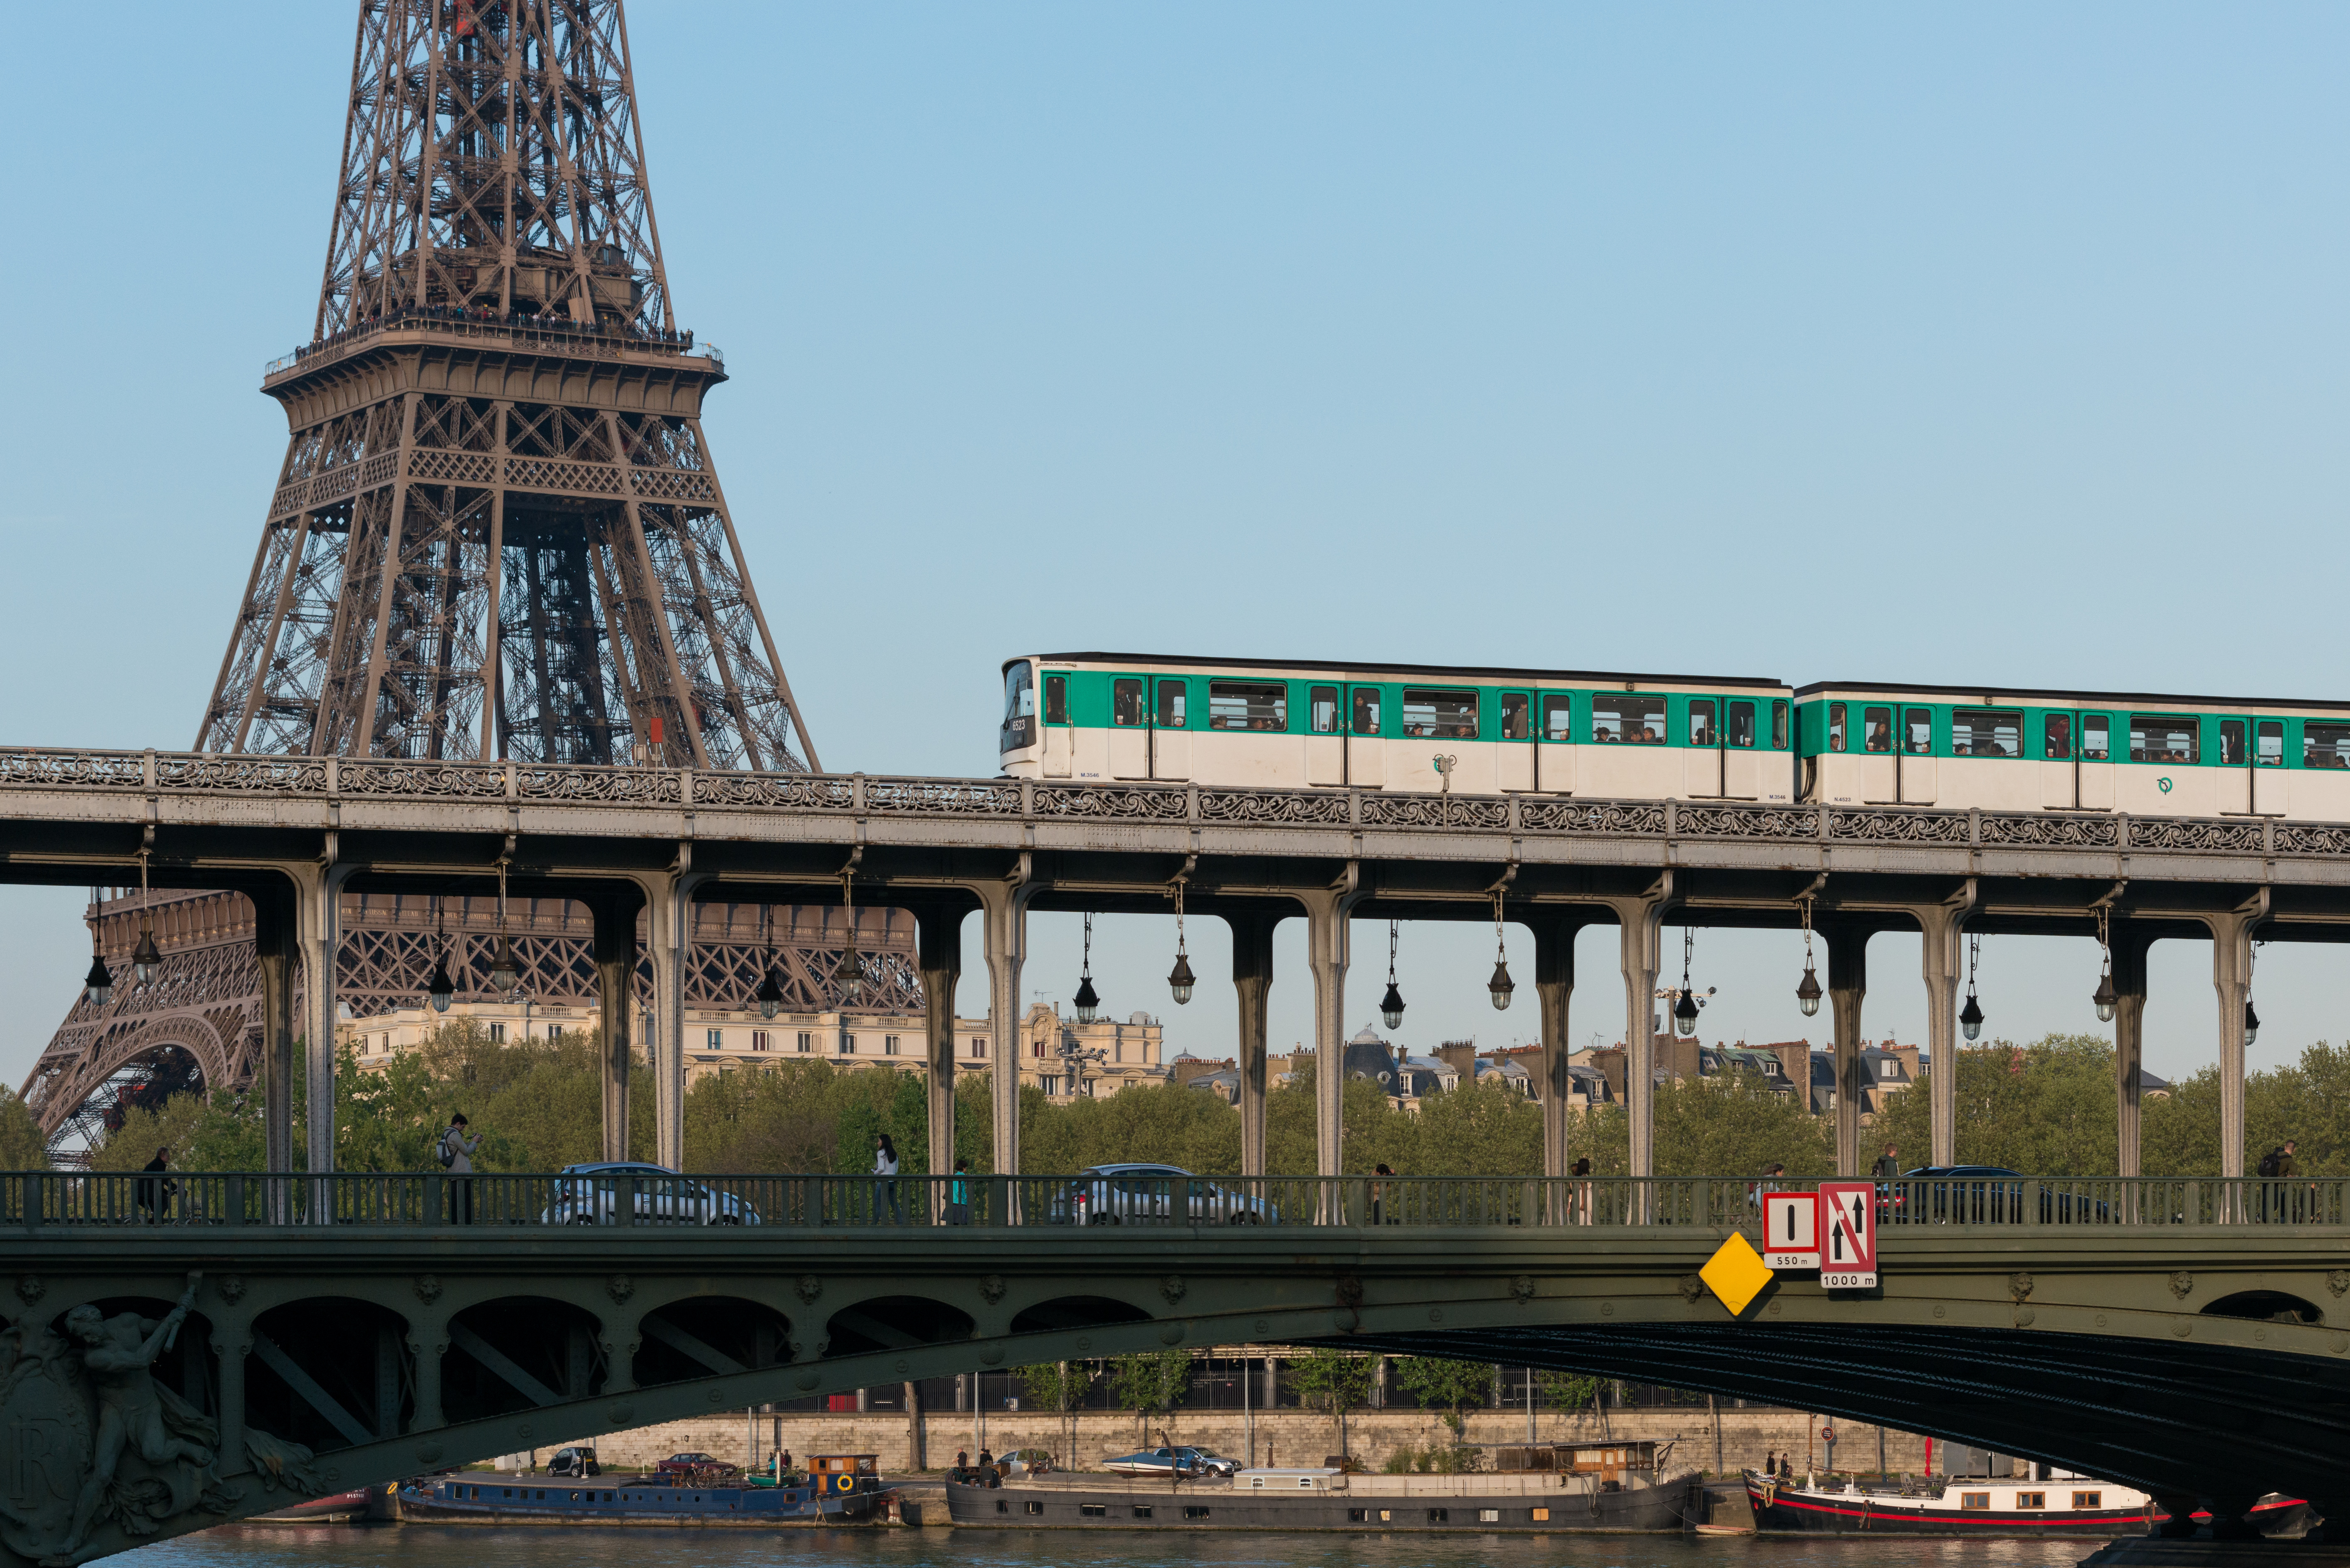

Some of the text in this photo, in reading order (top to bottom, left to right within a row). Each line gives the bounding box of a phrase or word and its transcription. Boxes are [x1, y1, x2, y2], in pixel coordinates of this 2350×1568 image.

[1013, 719, 1025, 731] 6523
[1777, 1256, 1798, 1265] 550
[1824, 1276, 1857, 1285] 1000
